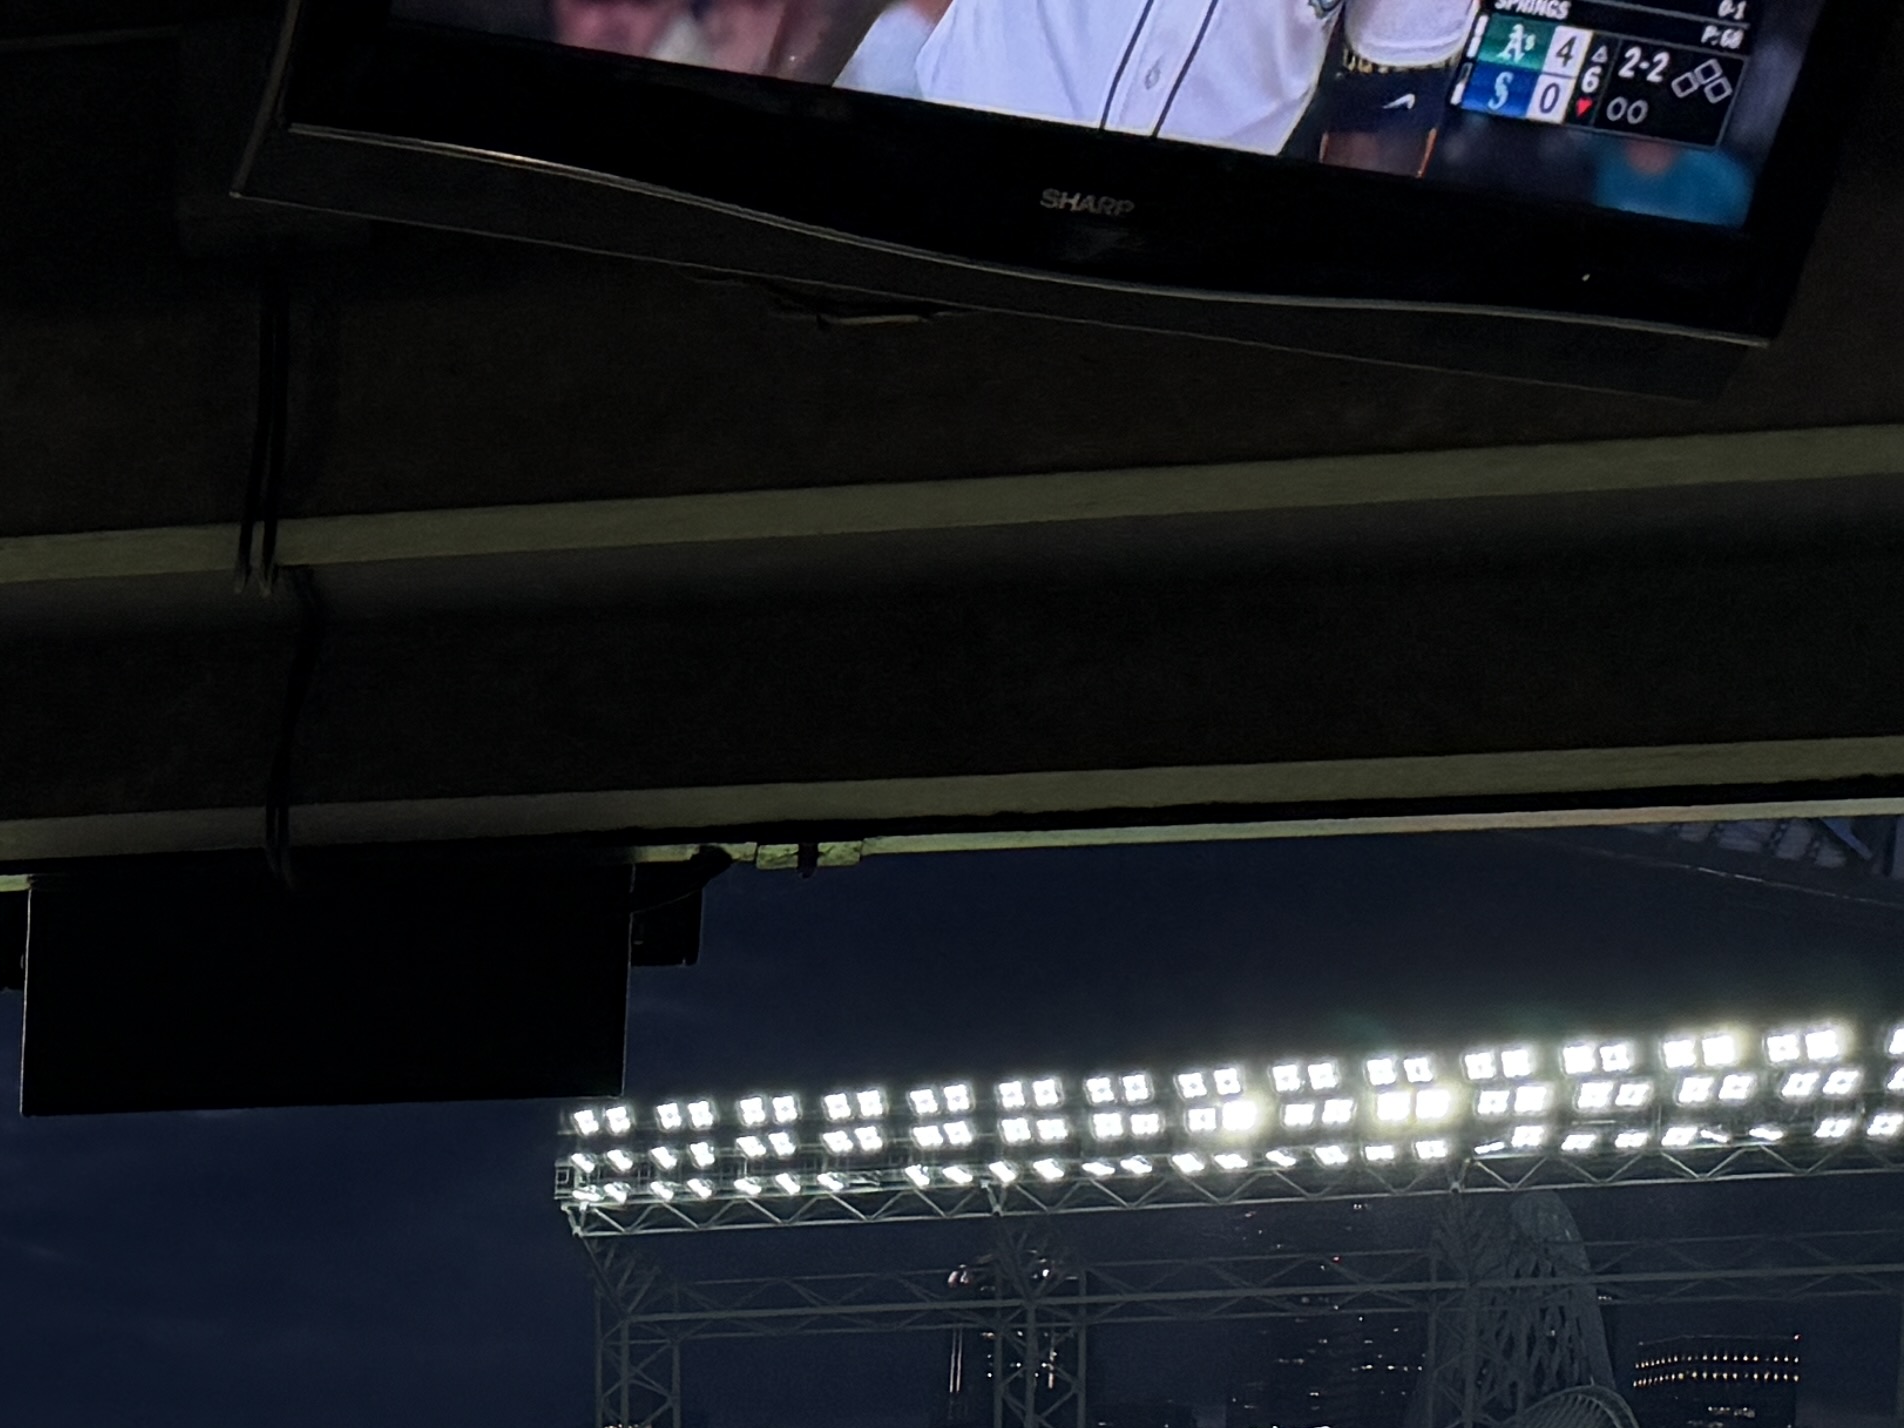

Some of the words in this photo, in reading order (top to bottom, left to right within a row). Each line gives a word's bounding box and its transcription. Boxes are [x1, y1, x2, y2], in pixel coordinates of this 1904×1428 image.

[1555, 36, 1578, 68] 4
[1618, 46, 1670, 83] 2-2
[1581, 65, 1600, 93] 6
[1539, 82, 1561, 114] 0
[1040, 188, 1135, 216] SHARP
